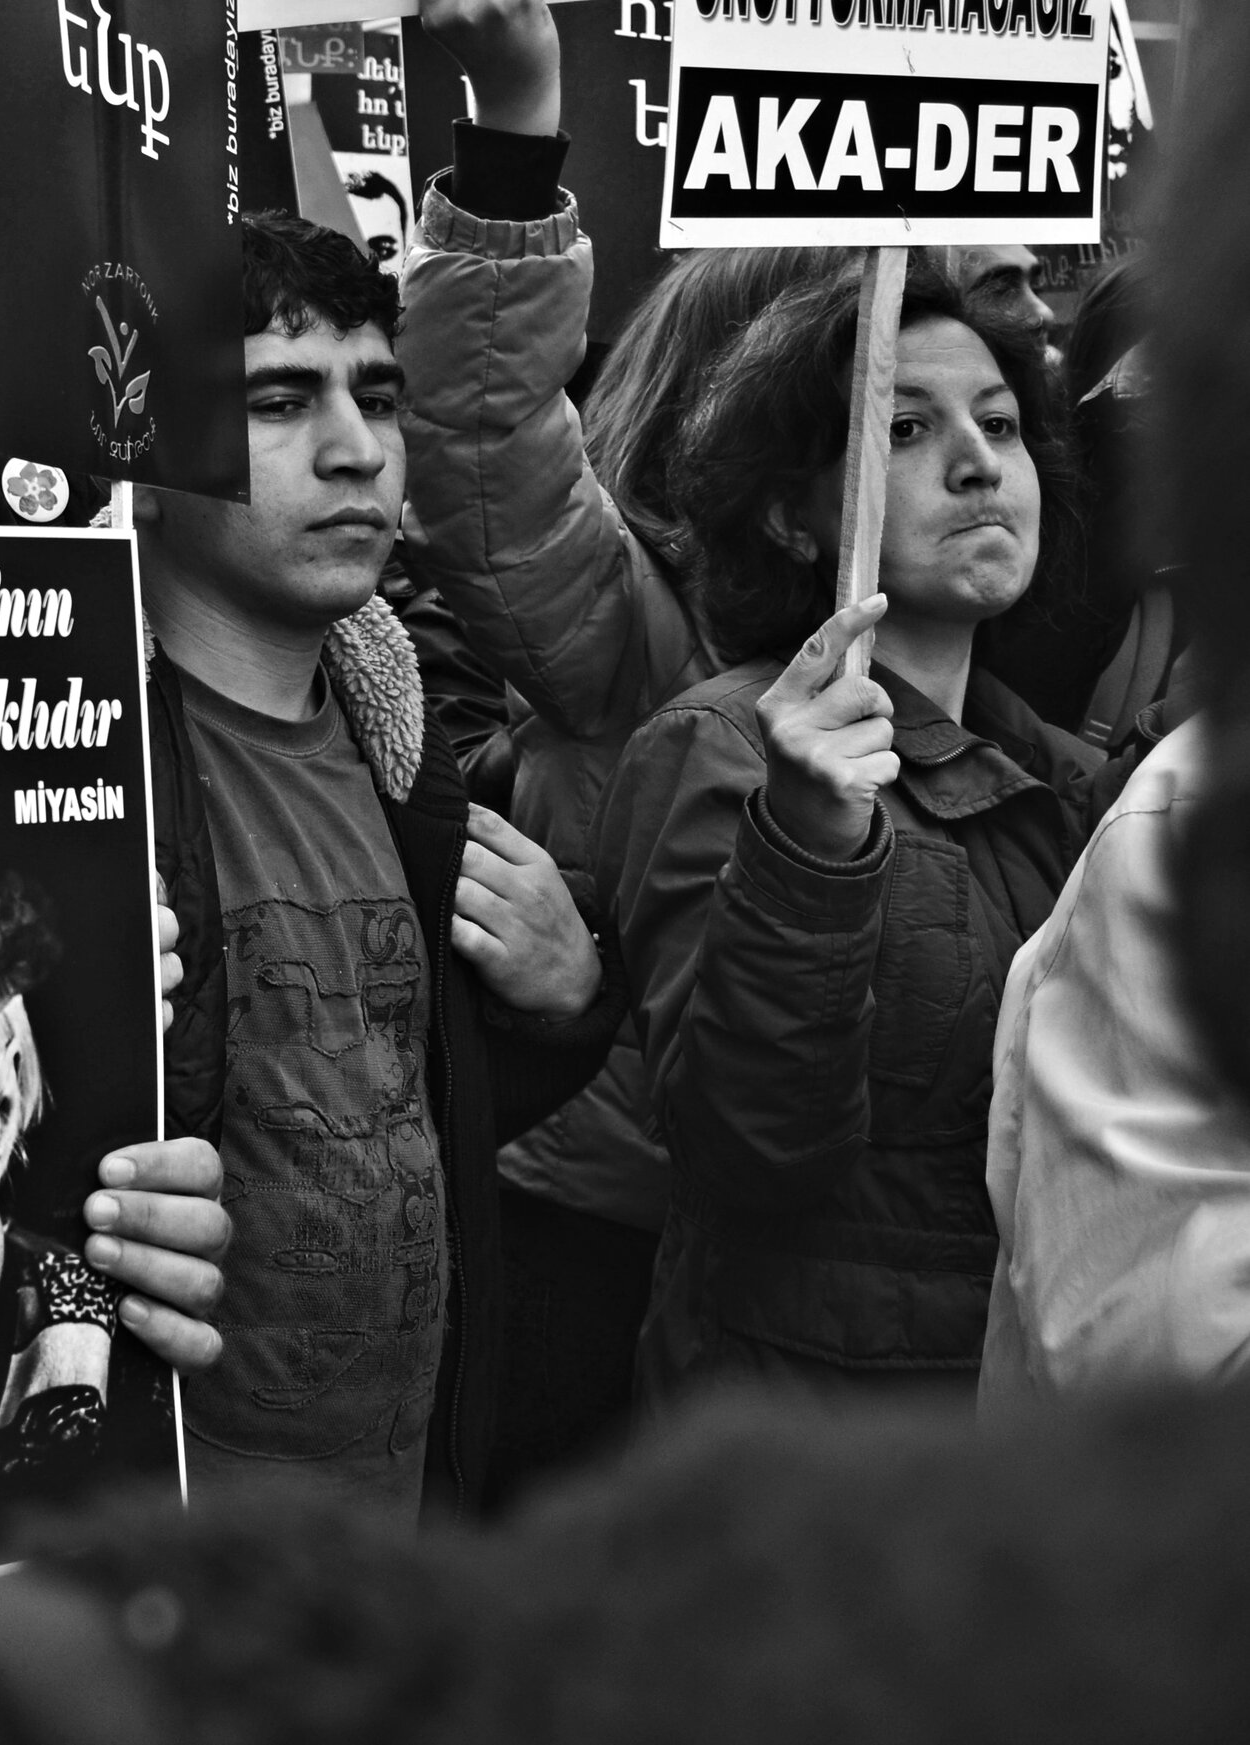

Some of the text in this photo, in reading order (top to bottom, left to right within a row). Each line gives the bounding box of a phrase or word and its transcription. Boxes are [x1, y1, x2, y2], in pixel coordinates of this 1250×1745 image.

[224, 0, 240, 155] buradayız
[682, 94, 1082, 194] AKA-DER
[80, 261, 159, 325] NOR ZARTONK
[13, 776, 126, 826] MİYASİN
